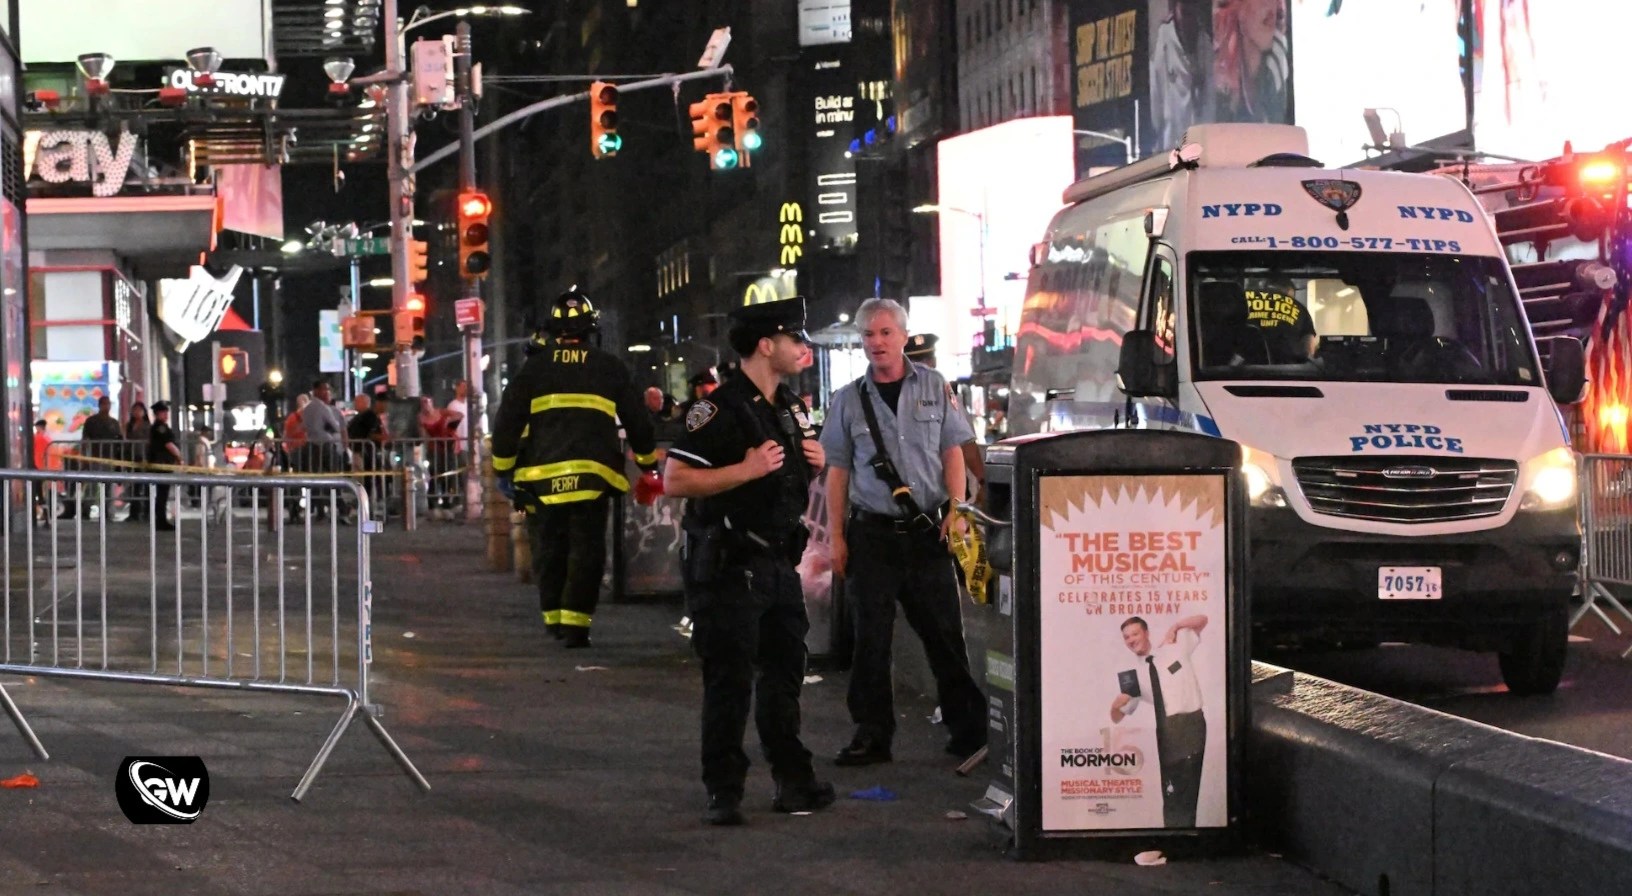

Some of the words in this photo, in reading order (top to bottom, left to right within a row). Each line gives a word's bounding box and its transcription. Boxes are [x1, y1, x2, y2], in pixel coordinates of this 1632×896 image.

[1202, 203, 1282, 218] NYPD
[1397, 205, 1474, 223] NYPD
[1267, 236, 1462, 252] 1-800-577-TIPS
[553, 350, 588, 363] FDNY
[1363, 424, 1441, 434] NYPD
[1349, 434, 1464, 453] POLICE
[551, 475, 580, 493] PERRY
[1128, 531, 1202, 551] BEST
[1072, 552, 1196, 572] MUSICAL
[1064, 574, 1085, 585] OF
[1091, 574, 1124, 584] THIS
[1384, 576, 1424, 592] 7057
[1425, 583, 1437, 592] 16
[1148, 590, 1161, 601] 15
[1167, 590, 1208, 601] YEARS
[1109, 603, 1181, 615] BROADWAY
[1061, 753, 1135, 767] MORMON
[1102, 779, 1142, 787] THEATER
[1115, 786, 1142, 794] STYLE
